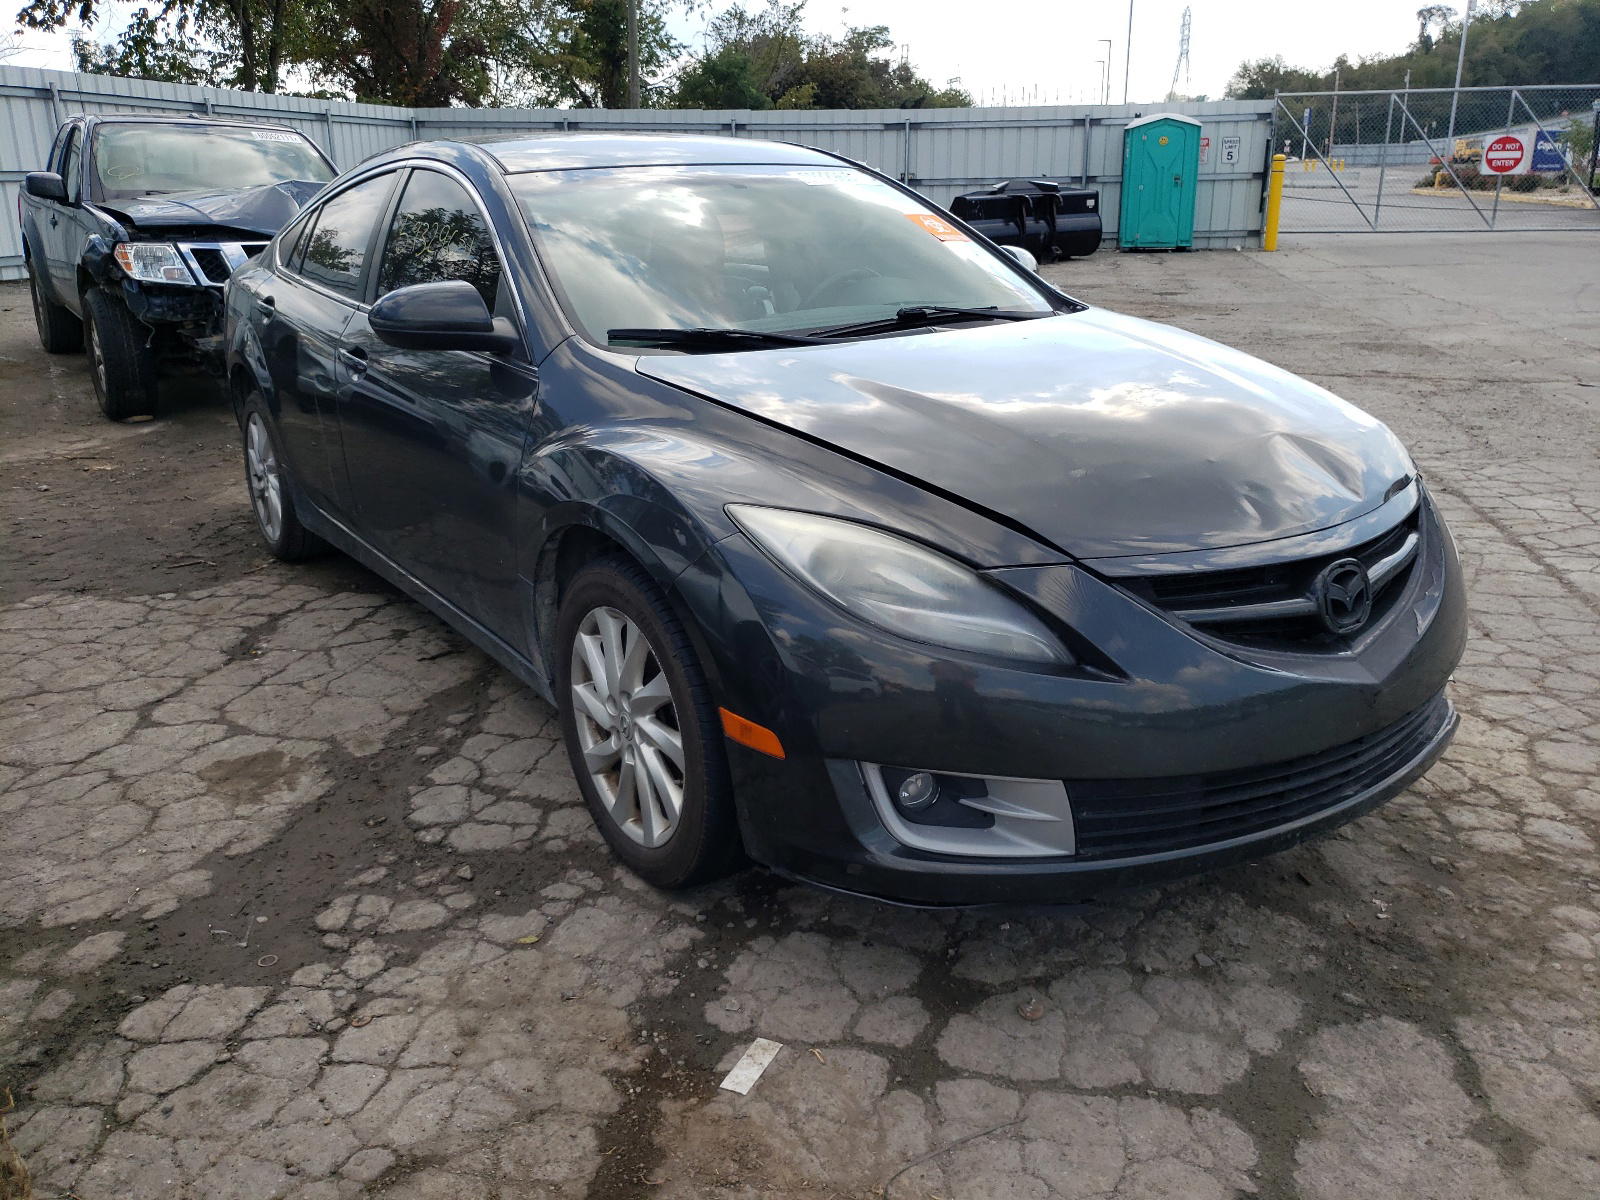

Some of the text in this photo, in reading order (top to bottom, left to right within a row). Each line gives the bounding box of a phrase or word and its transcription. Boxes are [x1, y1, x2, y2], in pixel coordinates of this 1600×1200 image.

[1491, 142, 1520, 151] DO NOT
[1226, 151, 1233, 160] 5
[1491, 159, 1515, 167] ENTER
